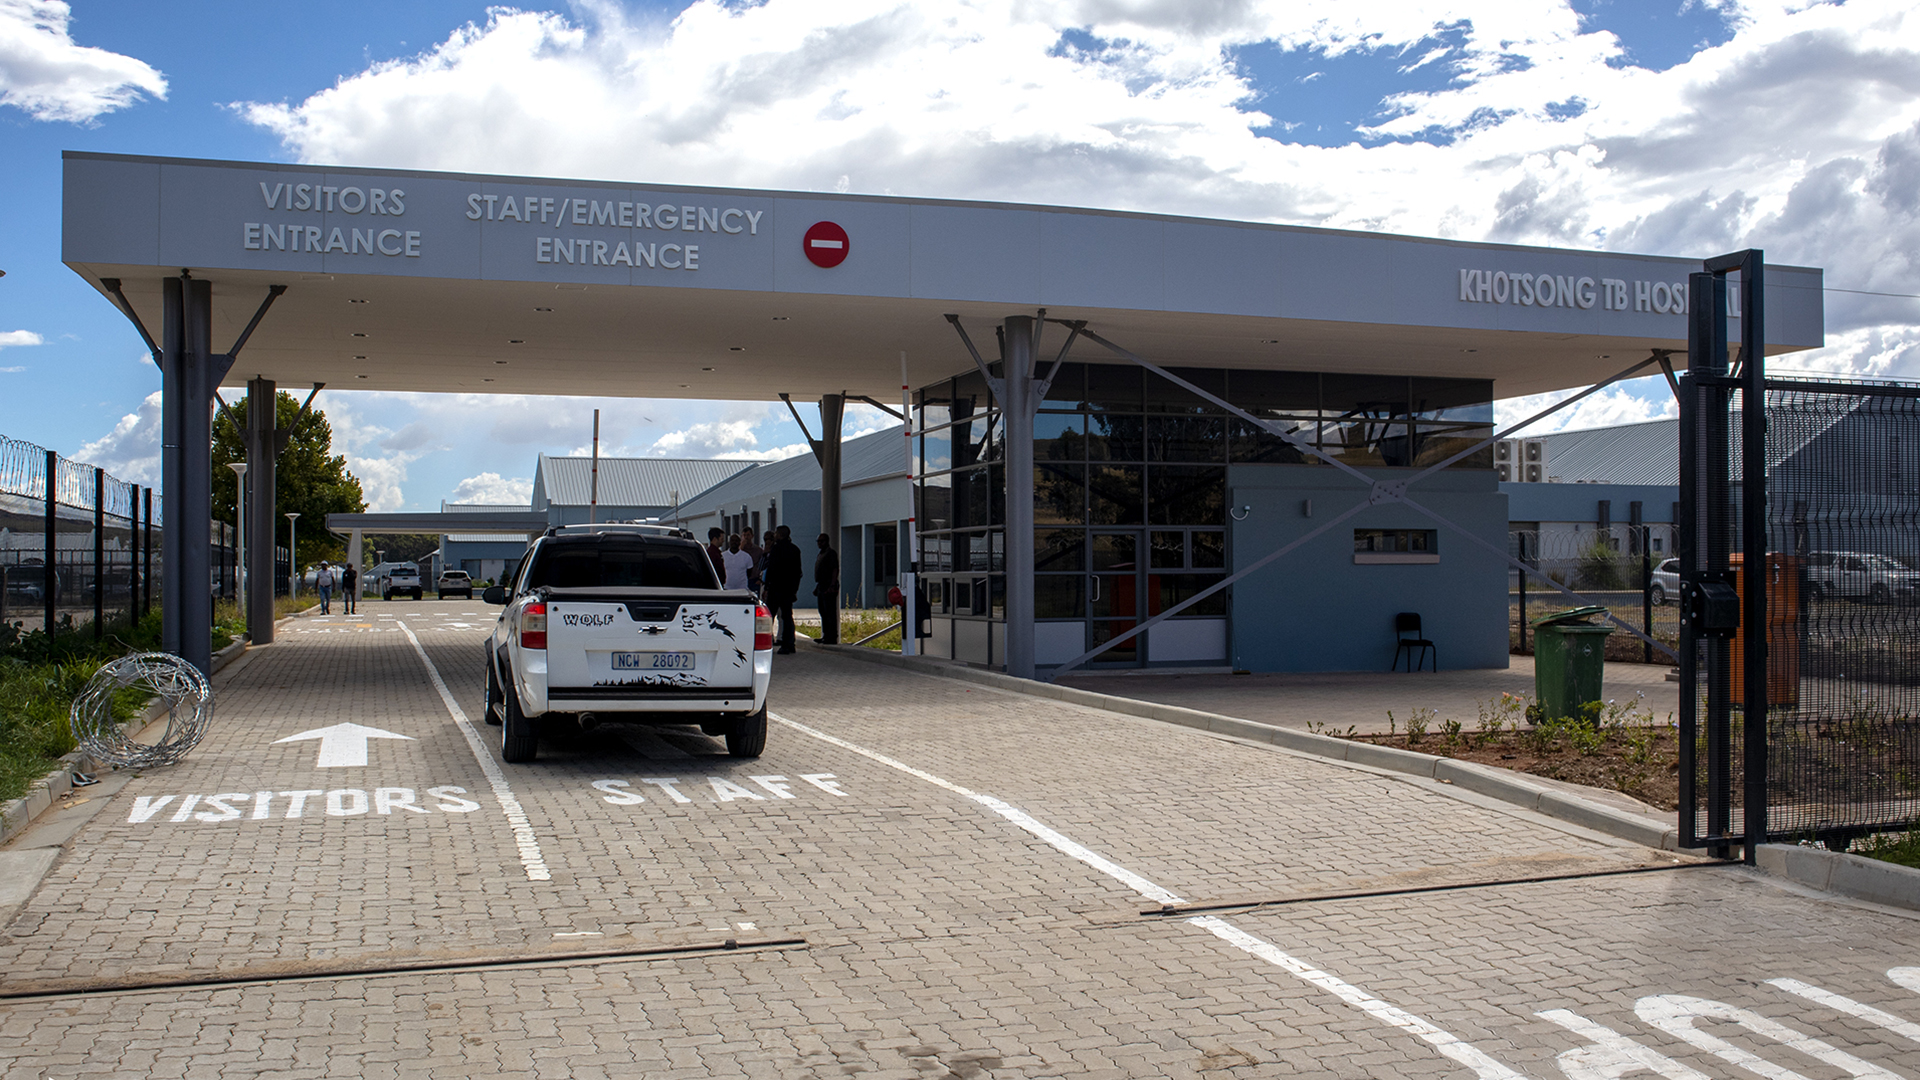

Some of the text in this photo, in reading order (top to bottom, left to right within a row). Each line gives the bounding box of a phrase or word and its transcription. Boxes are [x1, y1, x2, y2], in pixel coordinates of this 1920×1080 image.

[259, 181, 406, 216] VISITORS
[465, 193, 764, 235] STAFF/EMERGENCY
[243, 222, 421, 257] ENTRANCE
[536, 237, 700, 270] ENTRANCE
[1459, 268, 1598, 309] KHOTSONG
[1602, 278, 1629, 311] TB
[563, 613, 615, 627] WOLF
[618, 654, 689, 668] NCW 28092
[127, 785, 482, 824] VISITORS
[591, 773, 850, 806] STAFF
